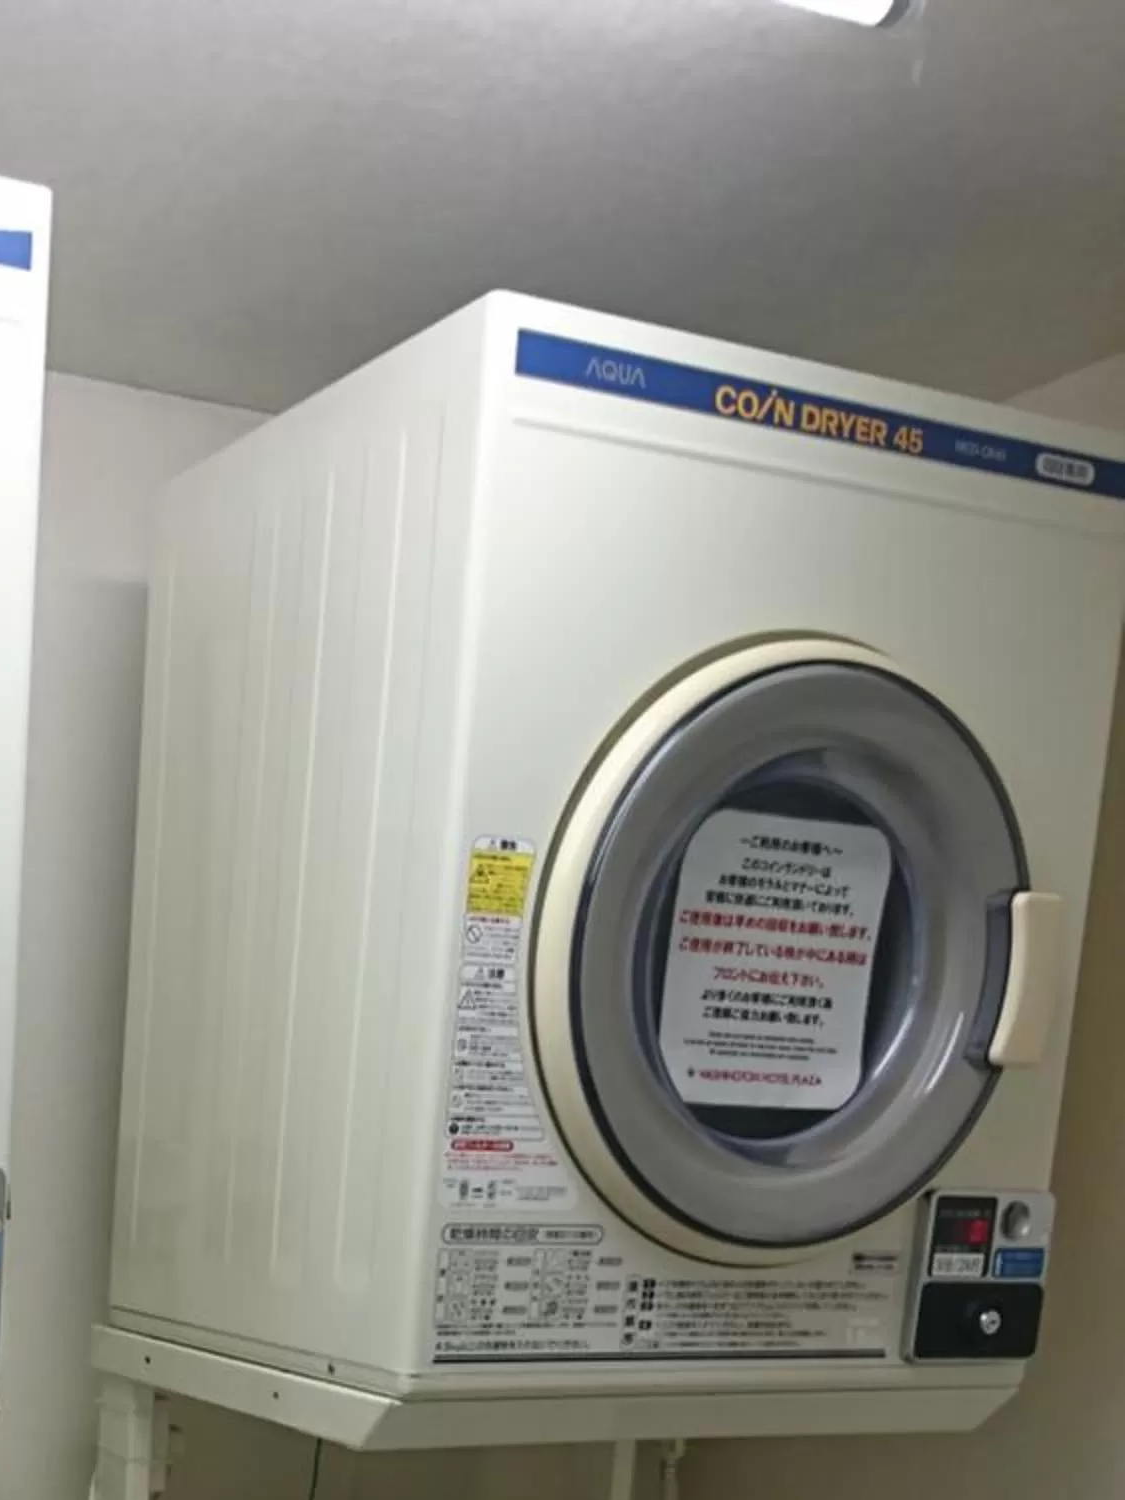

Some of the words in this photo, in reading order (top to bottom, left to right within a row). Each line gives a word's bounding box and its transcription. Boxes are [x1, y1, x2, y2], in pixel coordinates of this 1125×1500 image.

[586, 356, 646, 389] AQUA
[800, 404, 888, 446] DRYER
[893, 427, 924, 454] 45
